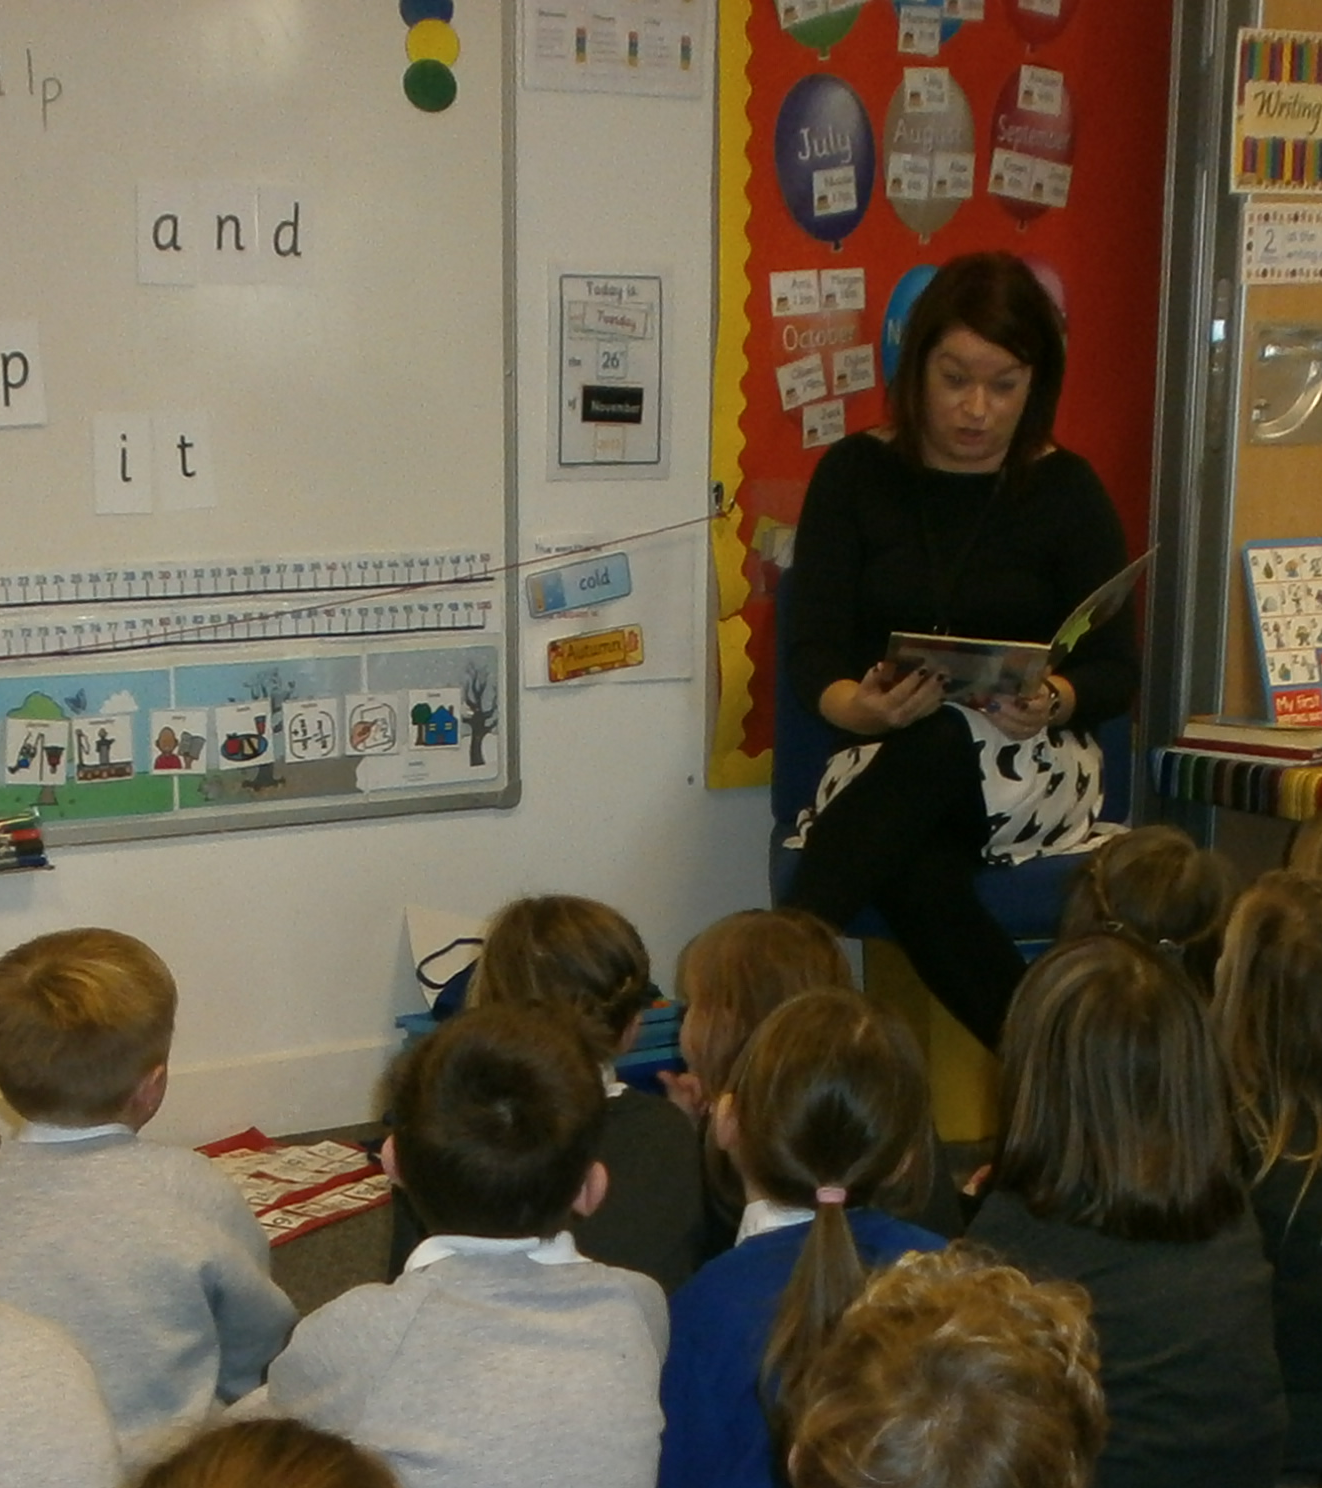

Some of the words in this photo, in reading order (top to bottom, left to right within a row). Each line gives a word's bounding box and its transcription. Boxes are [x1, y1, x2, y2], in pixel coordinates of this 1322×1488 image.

[1254, 90, 1322, 135] Writing
[798, 127, 852, 163] July
[893, 118, 962, 152] August
[586, 281, 624, 300] Today
[596, 309, 637, 331] Tuesday
[579, 567, 611, 590] cold
[567, 640, 621, 660] Autumn
